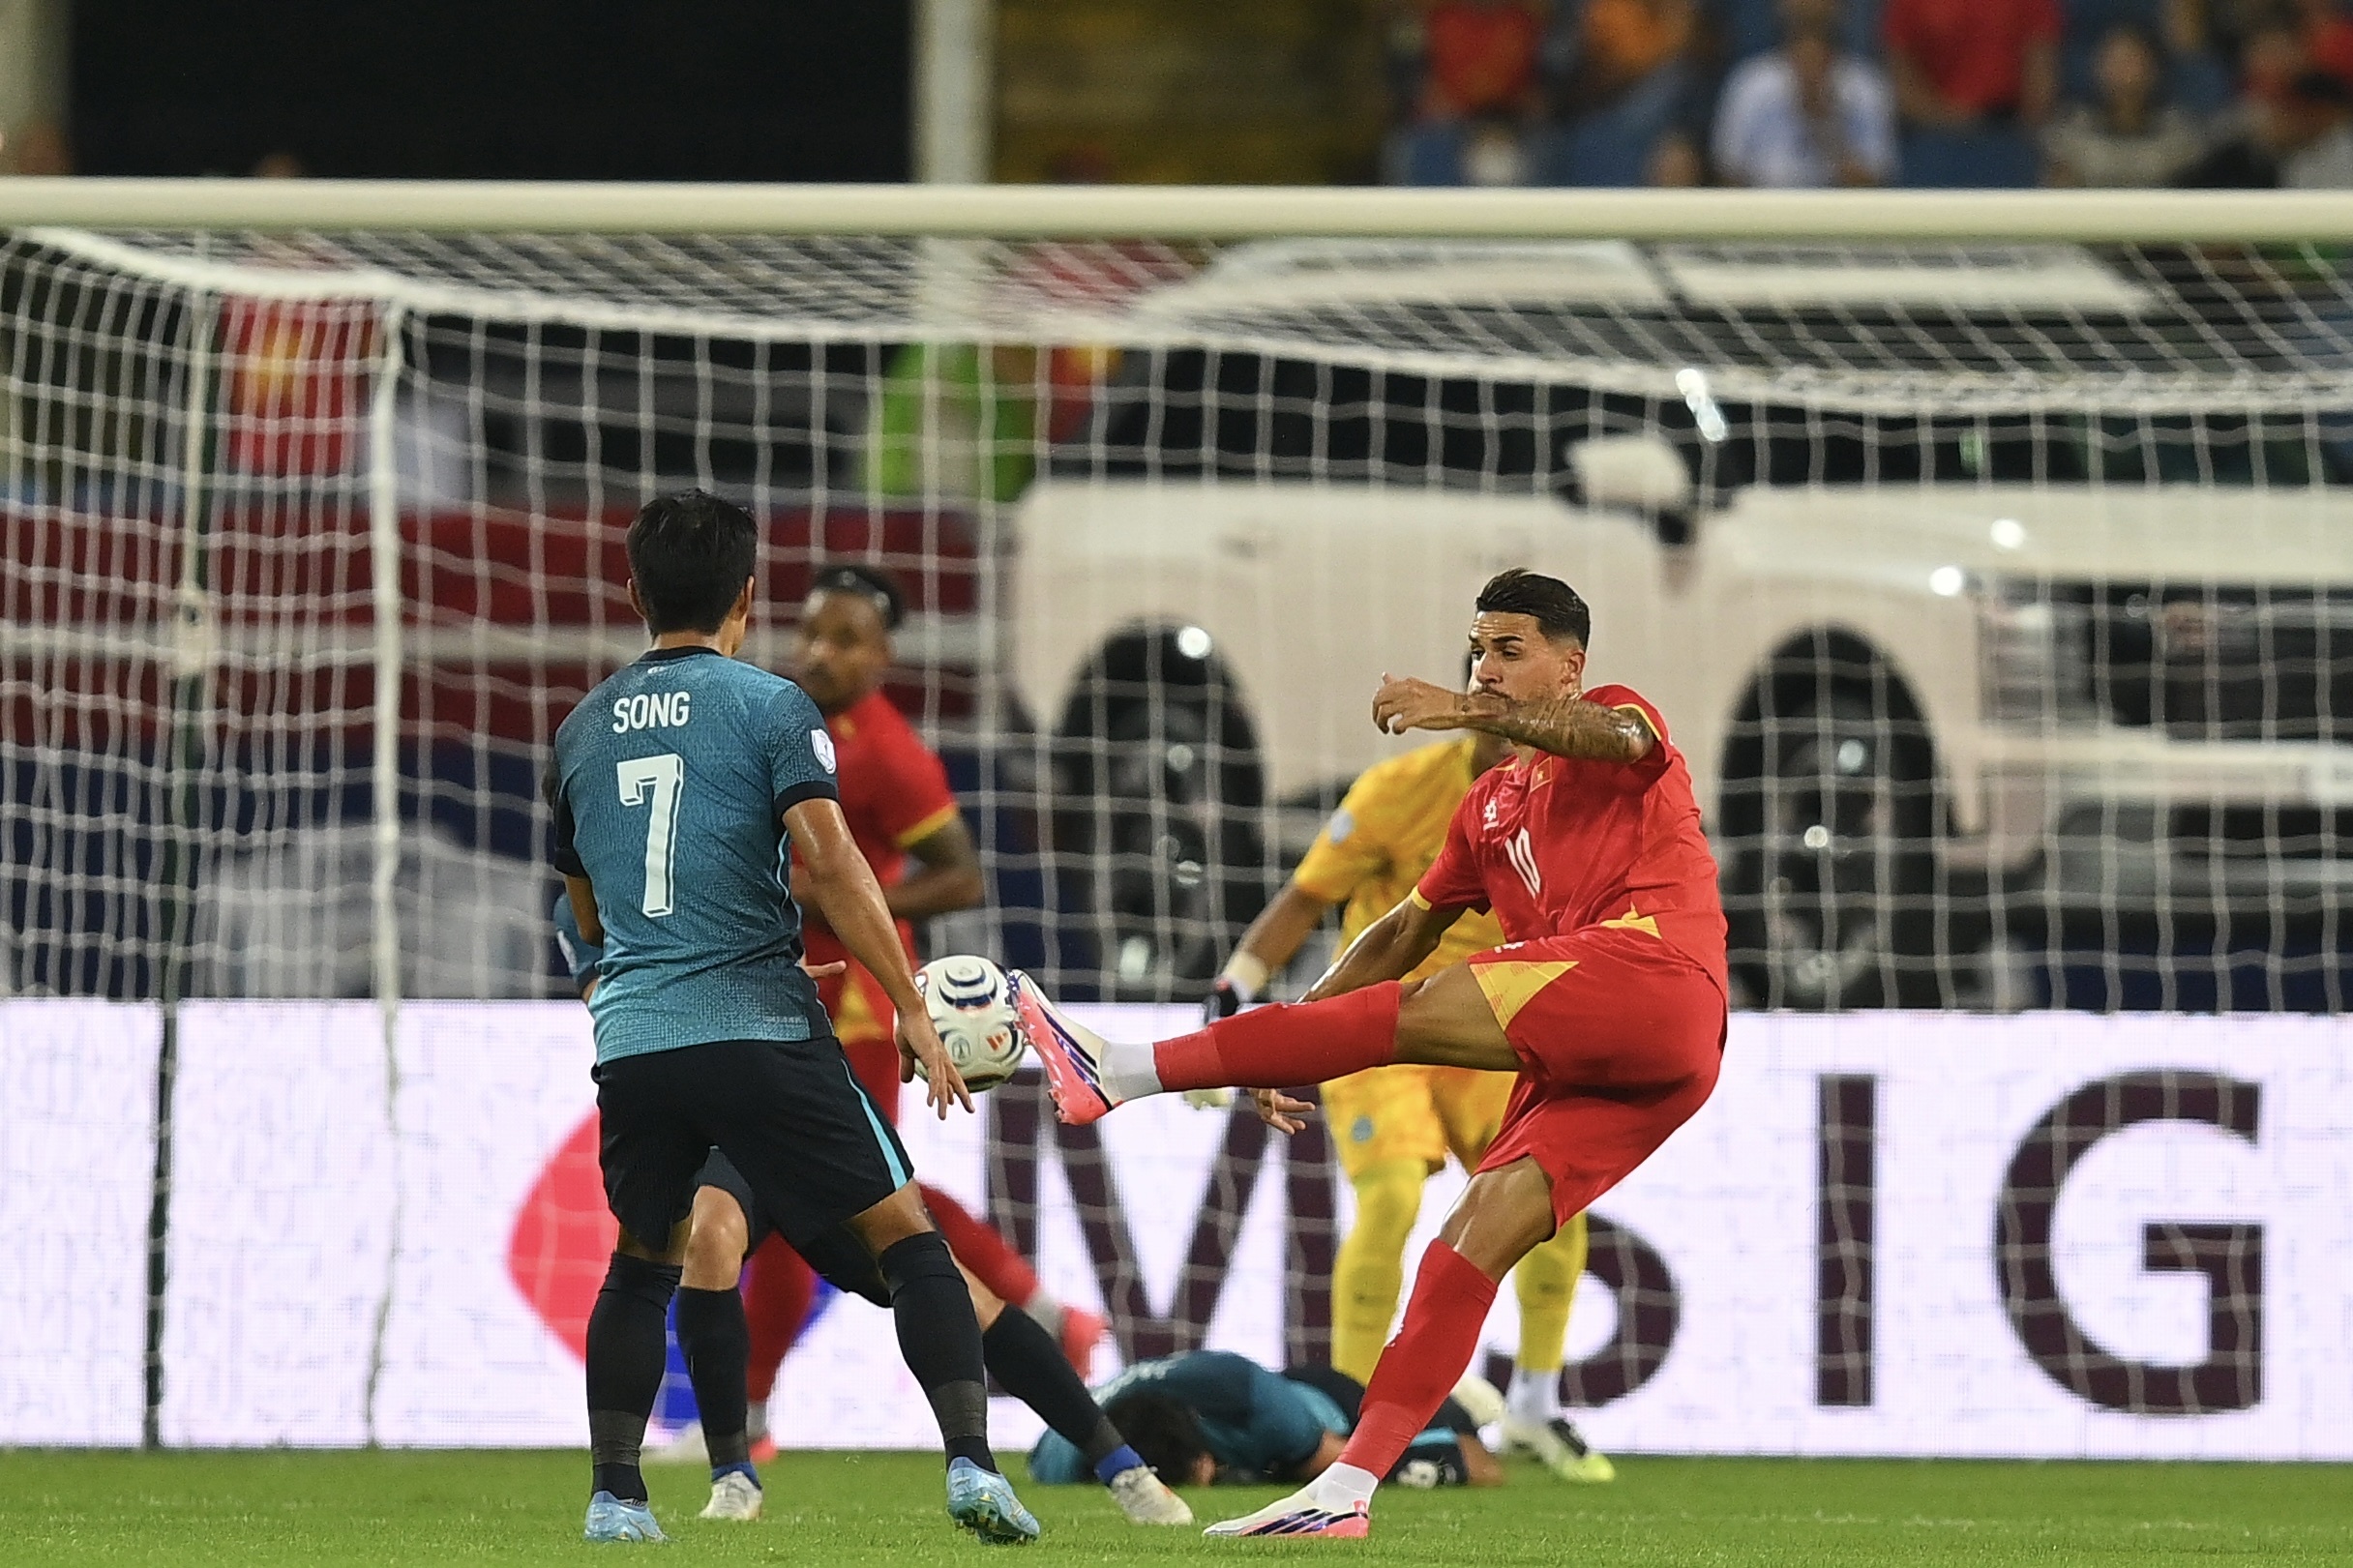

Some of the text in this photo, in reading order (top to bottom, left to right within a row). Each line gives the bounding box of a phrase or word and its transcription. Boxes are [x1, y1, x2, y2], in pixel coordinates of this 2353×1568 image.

[612, 691, 691, 734] SONG
[617, 753, 683, 918] 7
[1504, 826, 1541, 901] 10
